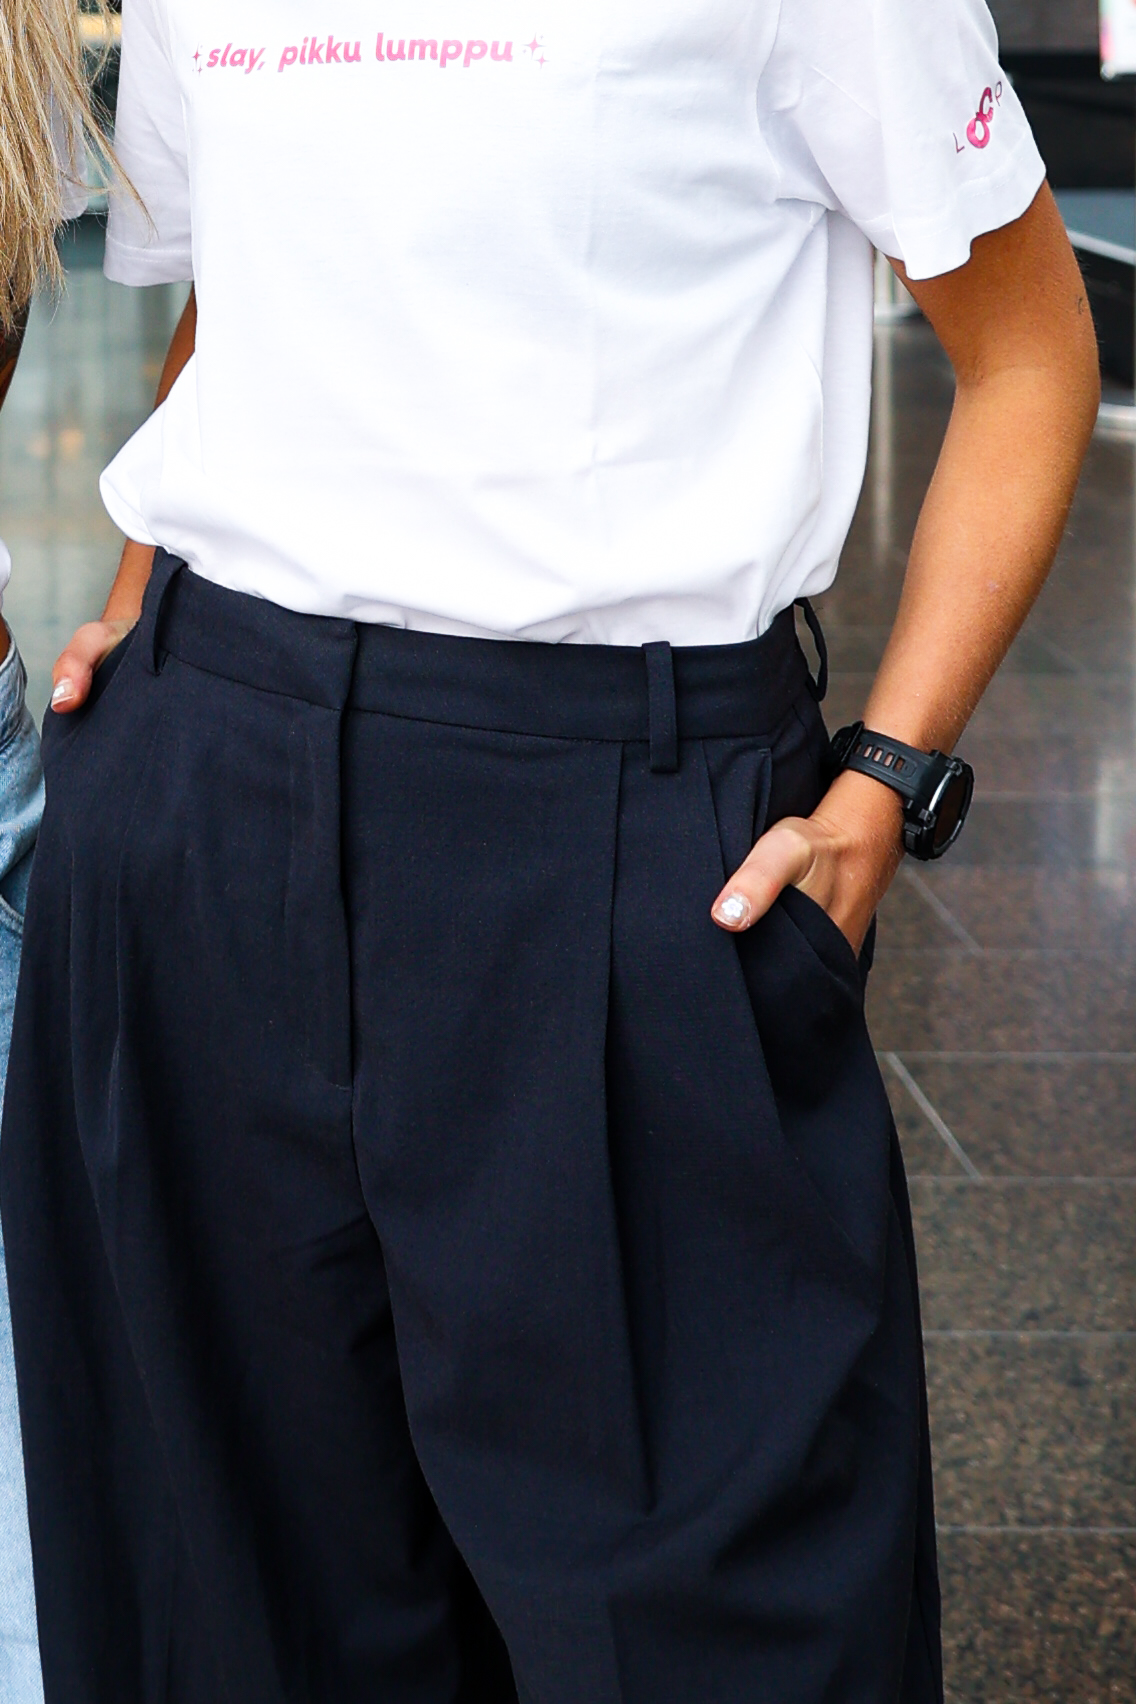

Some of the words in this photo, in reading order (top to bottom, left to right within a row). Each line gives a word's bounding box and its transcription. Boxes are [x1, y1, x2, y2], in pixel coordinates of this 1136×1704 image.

[205, 43, 266, 75] slay,
[277, 35, 362, 73] pikku
[374, 32, 514, 69] lumppu
